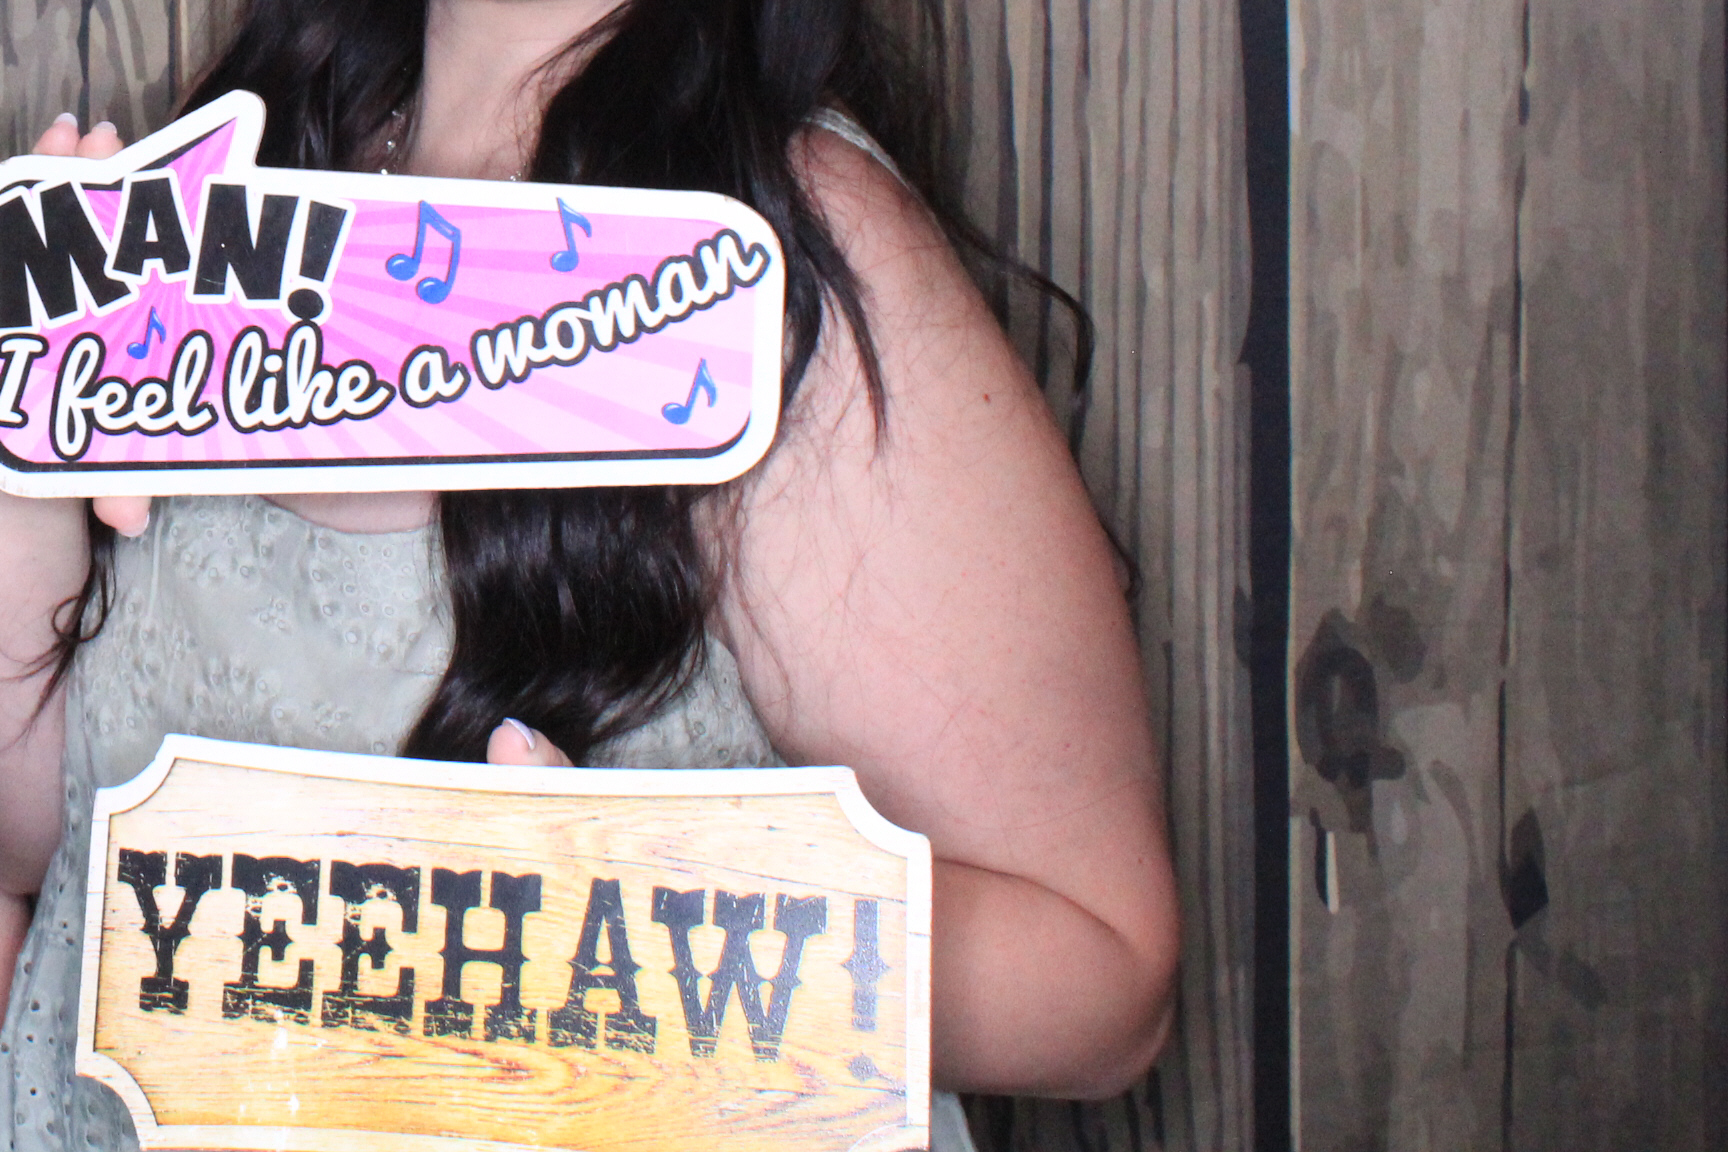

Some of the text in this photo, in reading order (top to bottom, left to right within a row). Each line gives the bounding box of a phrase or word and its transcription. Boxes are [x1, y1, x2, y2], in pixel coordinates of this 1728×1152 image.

[51, 330, 214, 460] feel
[226, 320, 392, 433] like
[401, 347, 469, 407] a
[475, 229, 769, 388] woman
[118, 849, 889, 1082] YEEHAW!
